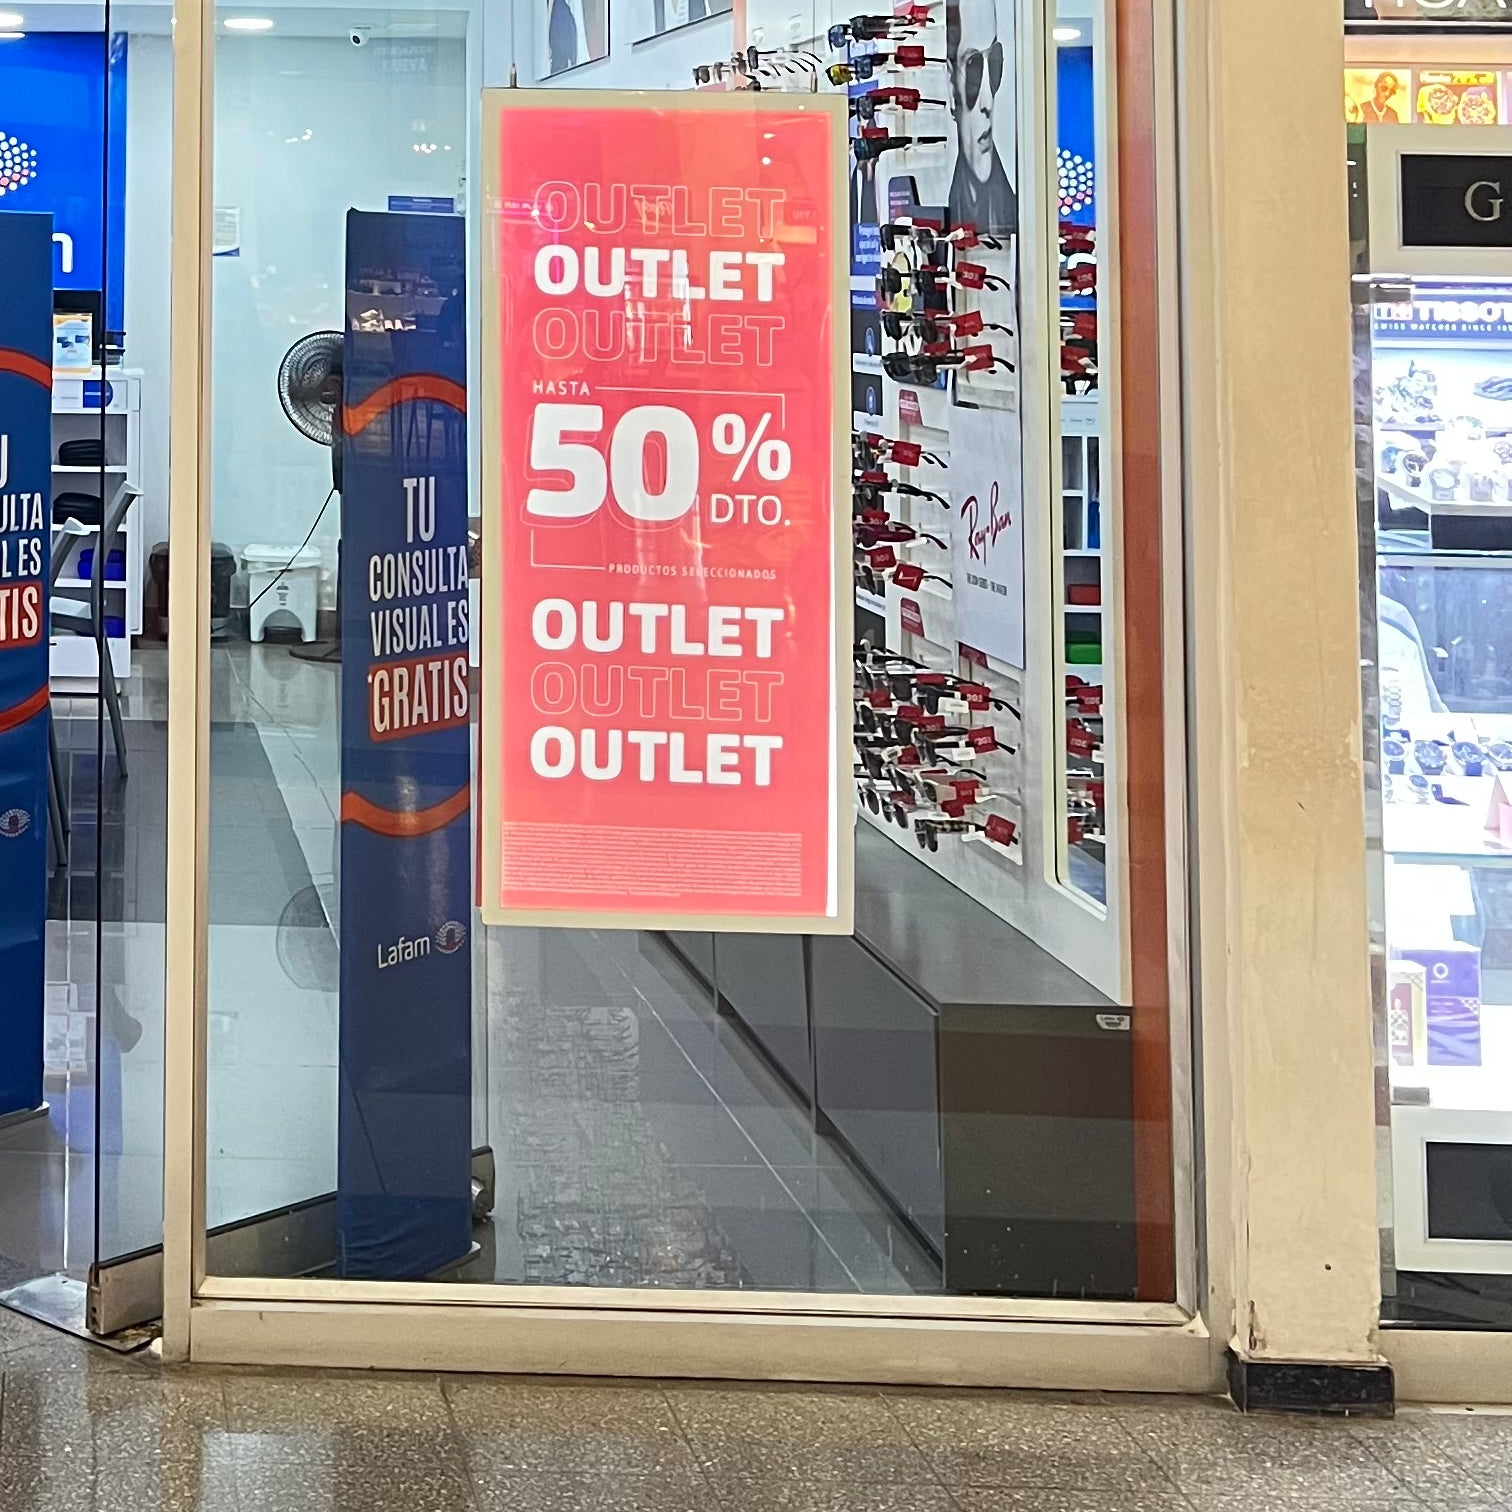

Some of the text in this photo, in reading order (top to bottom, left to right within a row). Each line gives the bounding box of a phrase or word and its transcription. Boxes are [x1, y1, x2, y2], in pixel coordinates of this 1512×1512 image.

[533, 181, 786, 238] OUTLET
[534, 244, 786, 302] OUTLET
[533, 307, 786, 366] OUTLET
[533, 380, 590, 396] HASTA
[403, 476, 436, 543] TU
[710, 494, 791, 527] DTO.
[18, 538, 42, 577] ES
[369, 545, 468, 602] CONSULTA
[609, 563, 777, 580] PRODUCTOS SELECCIONADOS
[370, 599, 468, 657] VISUAL ES
[531, 598, 785, 658] OUTLET
[530, 662, 785, 723] OUTLET
[530, 726, 783, 786] OUTLET
[378, 936, 430, 969] Lafam
